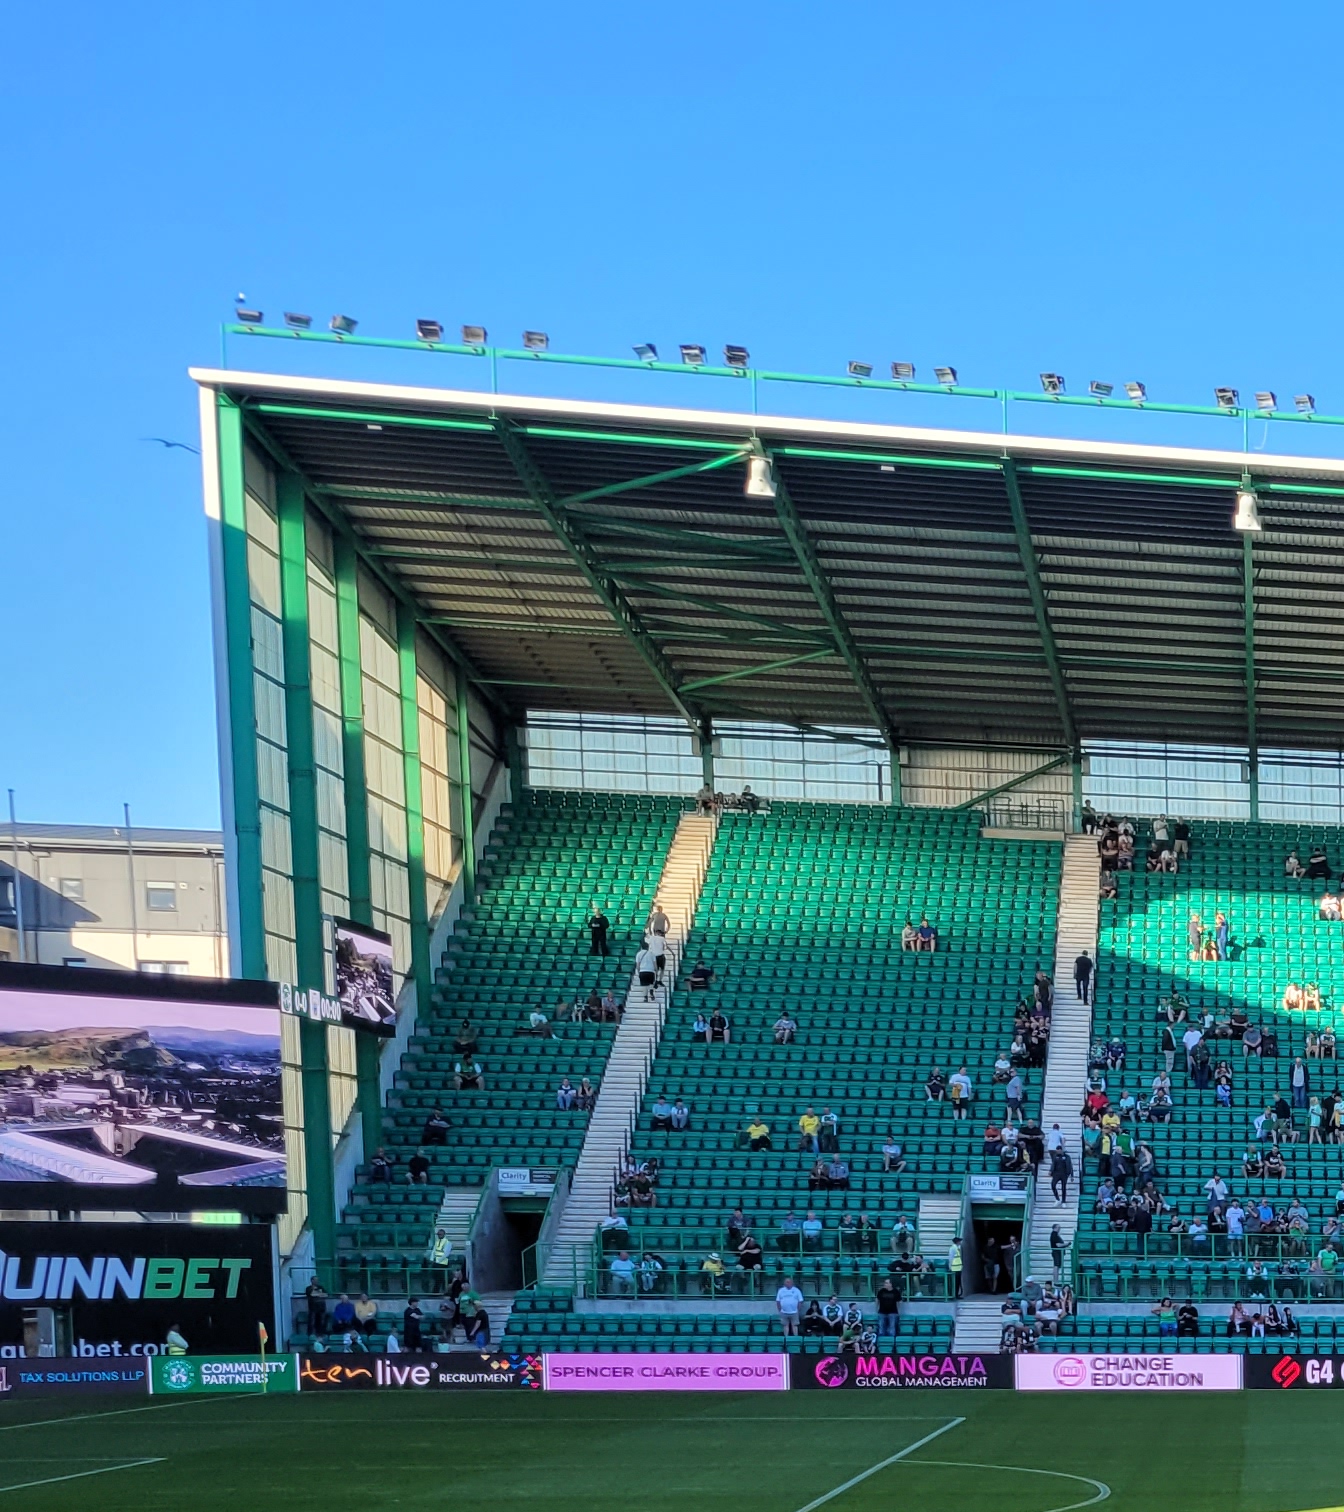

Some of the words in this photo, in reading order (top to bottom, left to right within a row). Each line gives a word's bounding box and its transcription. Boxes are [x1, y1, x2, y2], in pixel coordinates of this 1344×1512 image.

[501, 1172, 527, 1180] Clarity
[0, 1255, 252, 1300] UINNBET
[201, 1361, 288, 1374] COMMUNITY
[856, 1356, 987, 1375] MANGATA
[1090, 1357, 1174, 1371] CHANGE
[20, 1373, 43, 1383] TAX
[47, 1371, 120, 1383] SOLUTIONS
[122, 1371, 145, 1381] LLP
[377, 1360, 431, 1385] live
[440, 1373, 516, 1384] RECRUITMENT
[552, 1366, 634, 1378] SPENCER
[641, 1366, 710, 1378] CLARKE
[1306, 1360, 1334, 1384] G4
[201, 1373, 269, 1385] PARTNERS
[856, 1377, 903, 1387] GLOBAL
[906, 1377, 988, 1387] MANAGEMENT
[1090, 1373, 1204, 1387] EDUCATION
